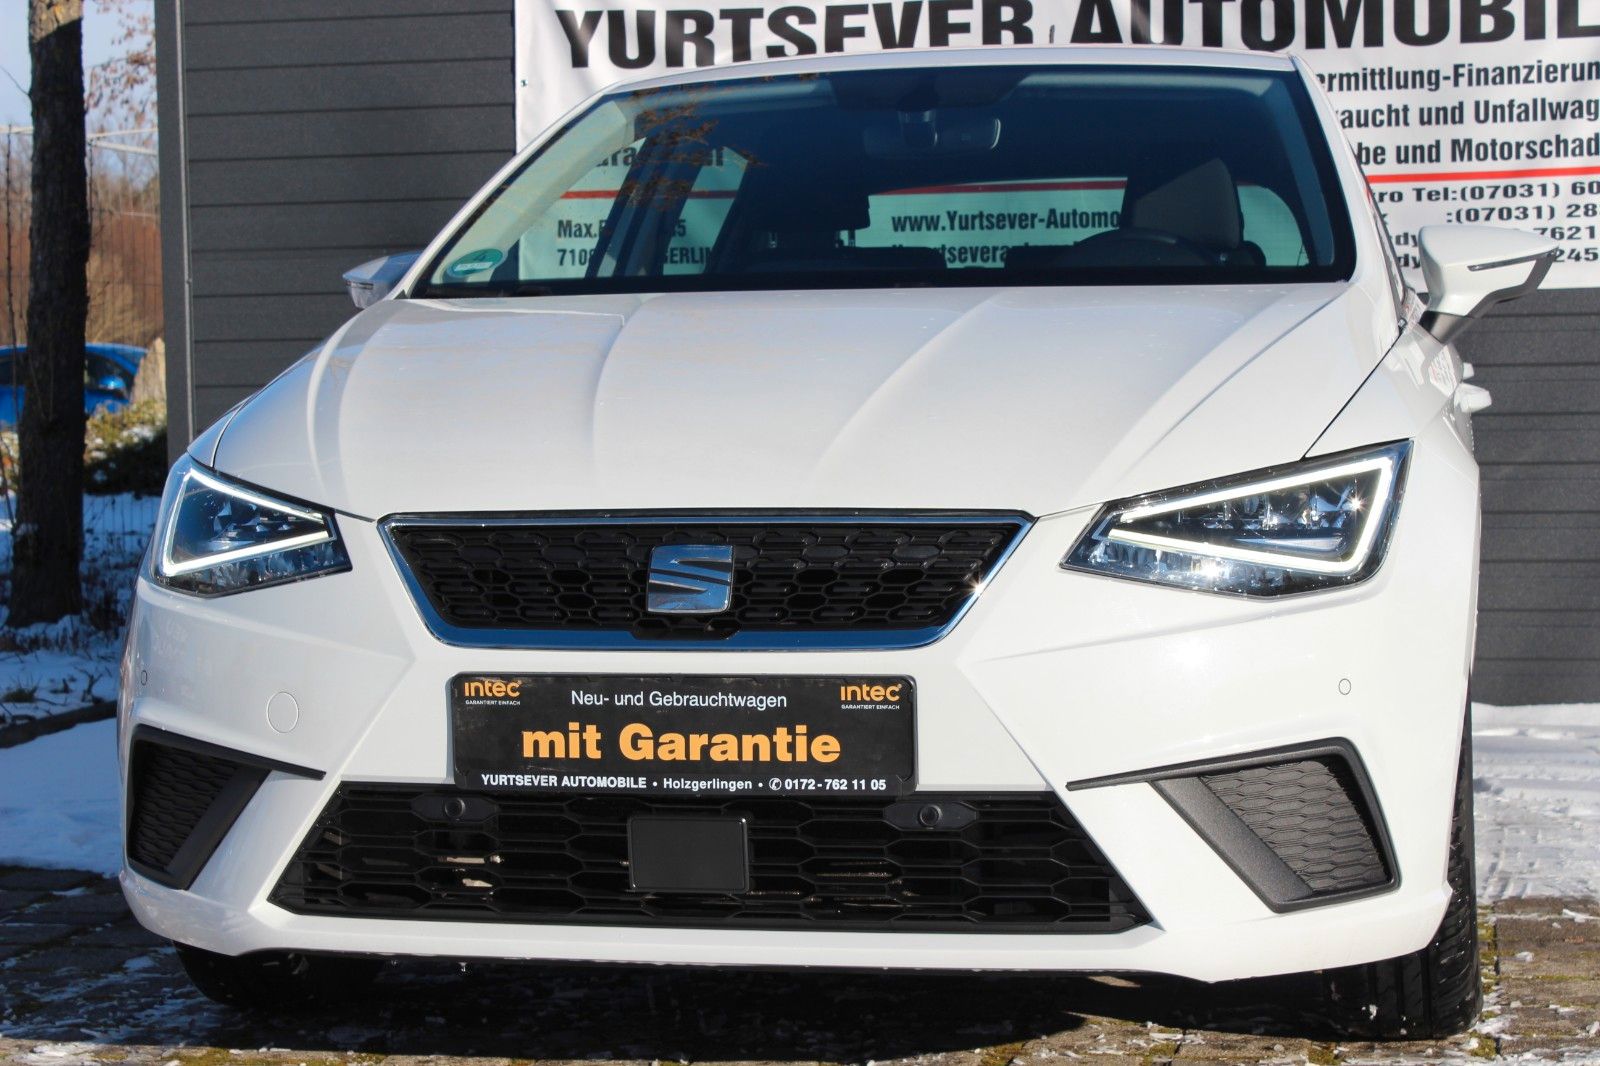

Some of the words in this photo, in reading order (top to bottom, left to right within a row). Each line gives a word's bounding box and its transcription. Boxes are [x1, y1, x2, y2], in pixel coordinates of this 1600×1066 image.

[555, 2, 1034, 68] YURTSEVER
[1069, 0, 1600, 52] AUTOMOBIL
[1335, 103, 1410, 129] aucht
[1419, 101, 1464, 126] und
[1474, 97, 1600, 124] Unfallwag
[1396, 139, 1441, 163] und
[1450, 132, 1600, 162] Motorschad
[1373, 191, 1404, 203] ro
[464, 680, 521, 697] intec
[840, 683, 901, 702] intec
[571, 690, 609, 706] Neu-
[614, 691, 644, 706] und
[649, 691, 787, 711] Gebrauchtwagen
[522, 721, 602, 760] mit
[619, 722, 841, 763] Garantie
[481, 774, 558, 787] YURTSEVER
[561, 775, 647, 789] AUTOMOBILE
[663, 777, 753, 792] Holzgerlingen
[851, 778, 866, 791] 11
[870, 779, 887, 791] 05
